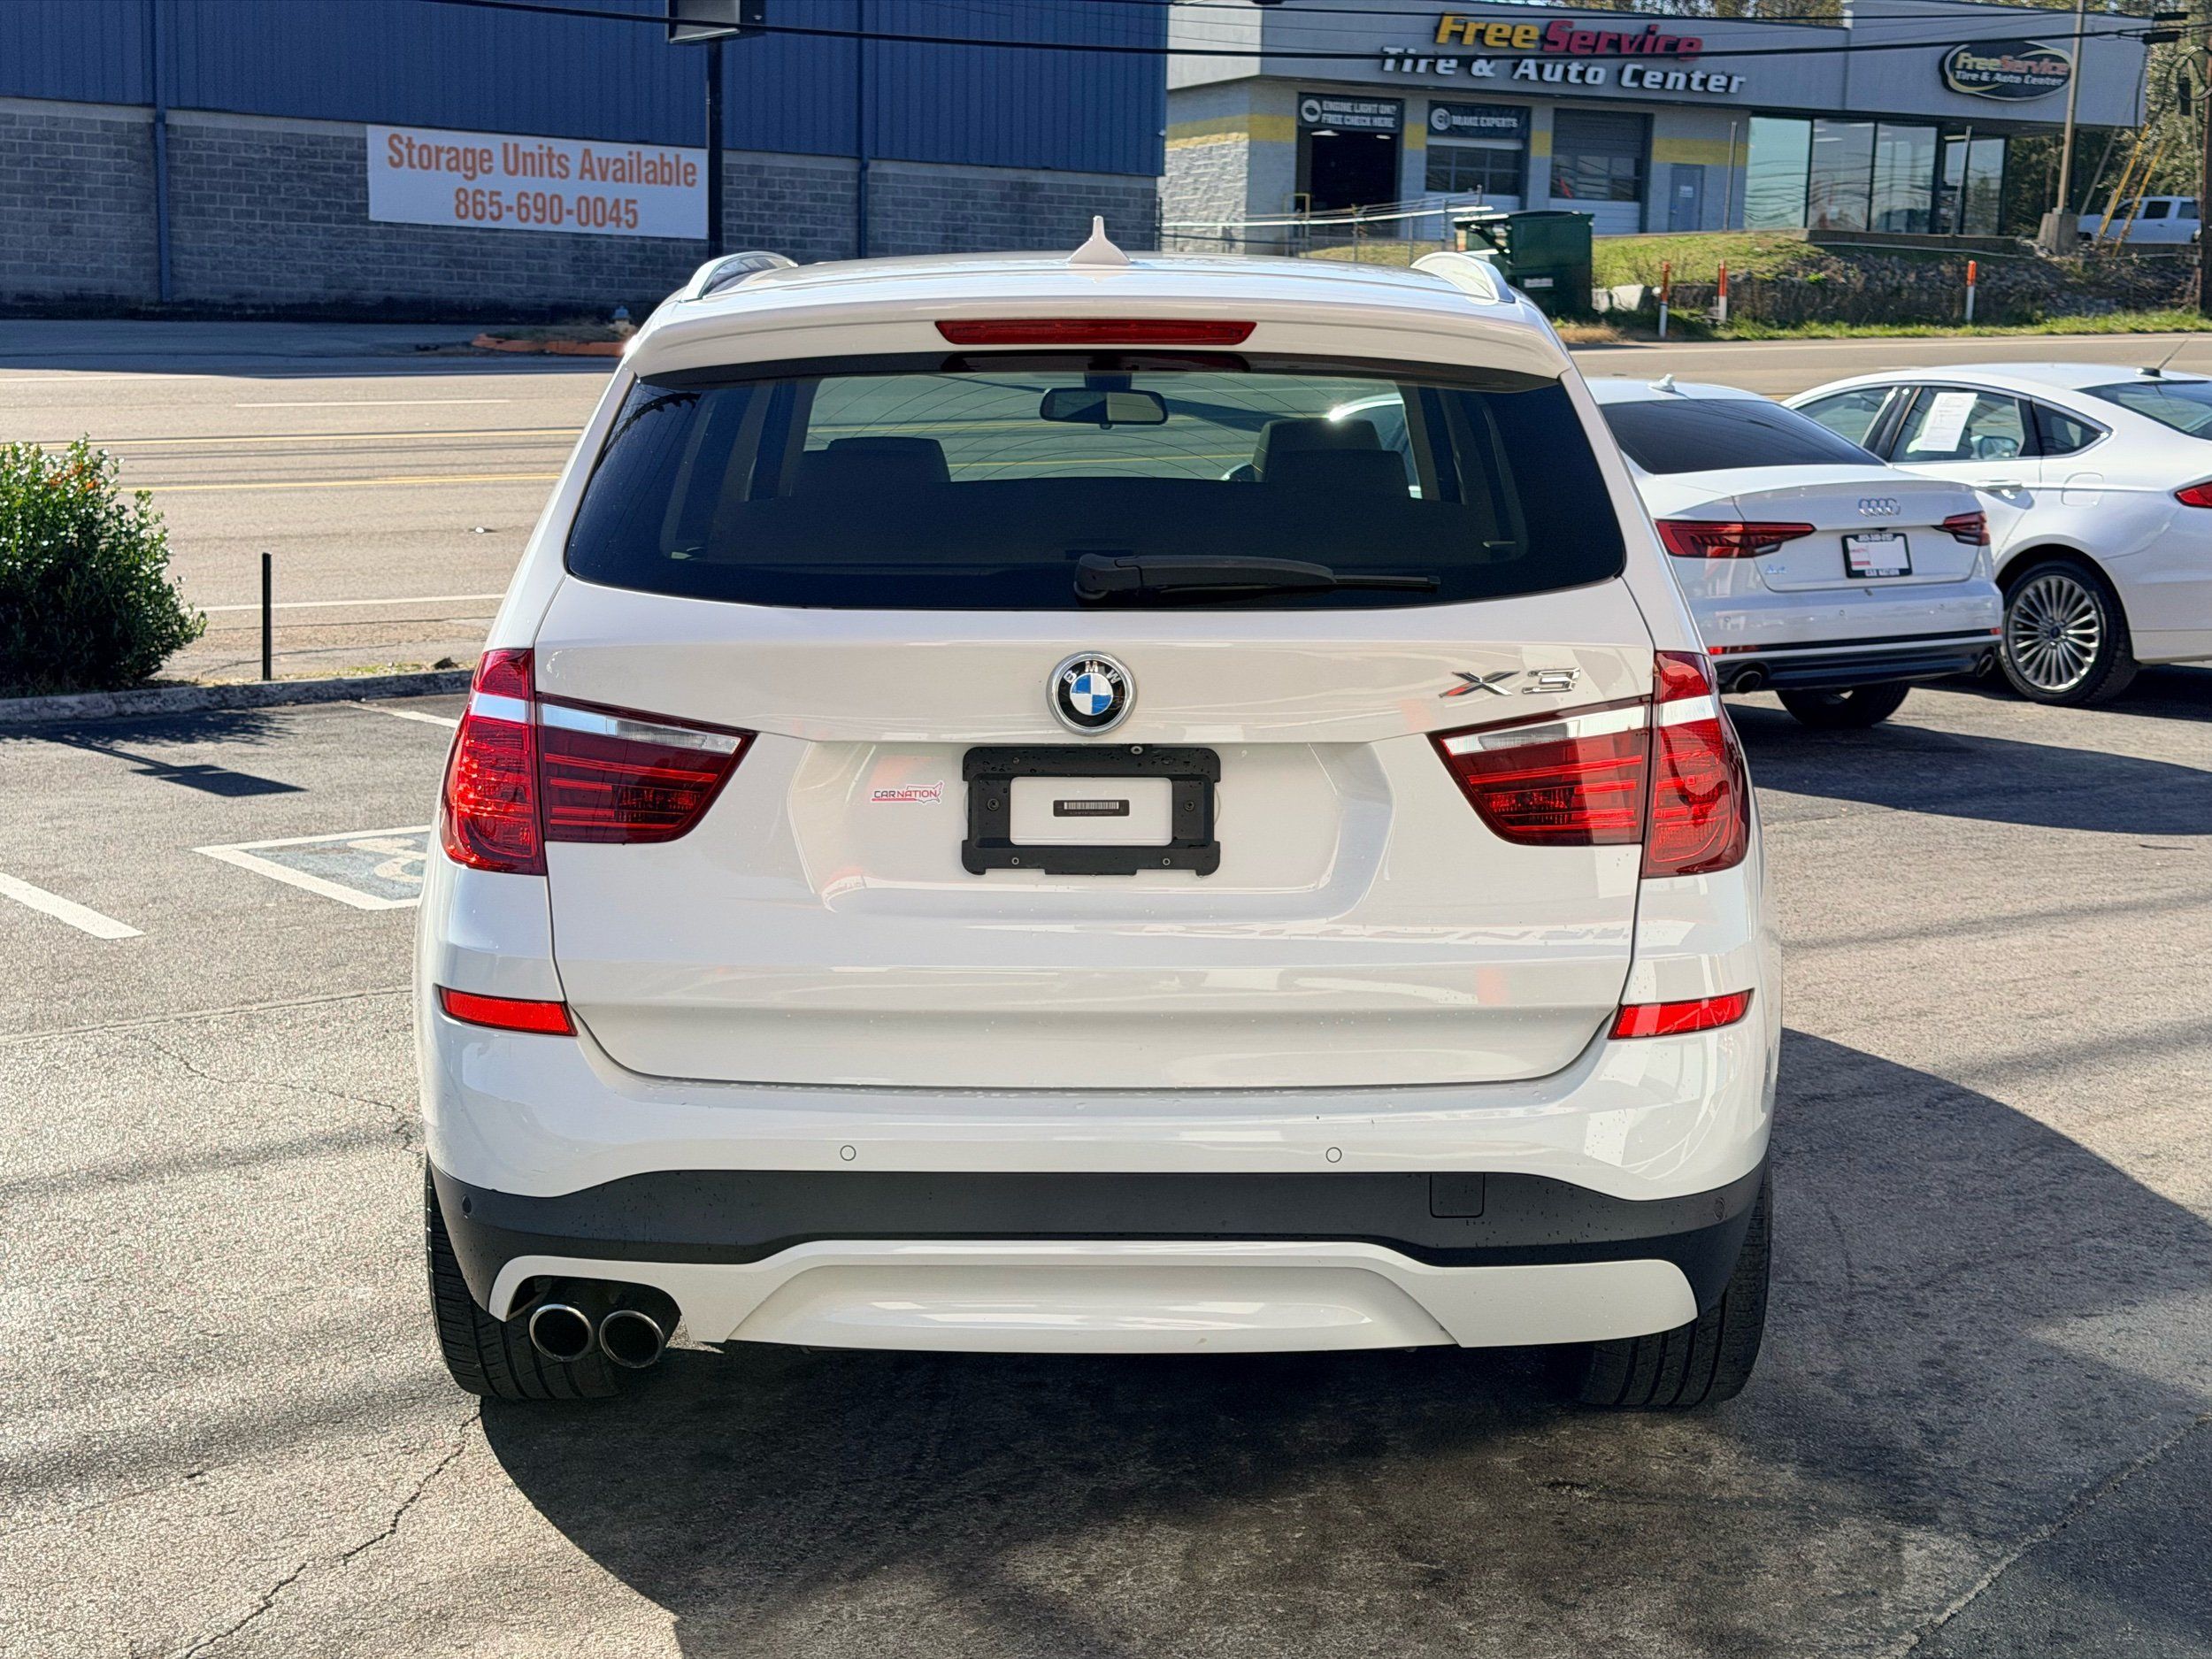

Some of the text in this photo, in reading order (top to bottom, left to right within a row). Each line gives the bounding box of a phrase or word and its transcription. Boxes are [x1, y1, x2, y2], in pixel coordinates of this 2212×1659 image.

[1381, 47, 1747, 94] Tire & Auto Center
[1955, 71, 1979, 81] Tire
[1993, 73, 2023, 84] Auto
[2024, 75, 2064, 86] Center
[388, 133, 697, 188] Storage Units Available
[455, 188, 637, 229] 865-690-0045
[1063, 660, 1122, 684] BMW
[1439, 667, 1580, 697] X3
